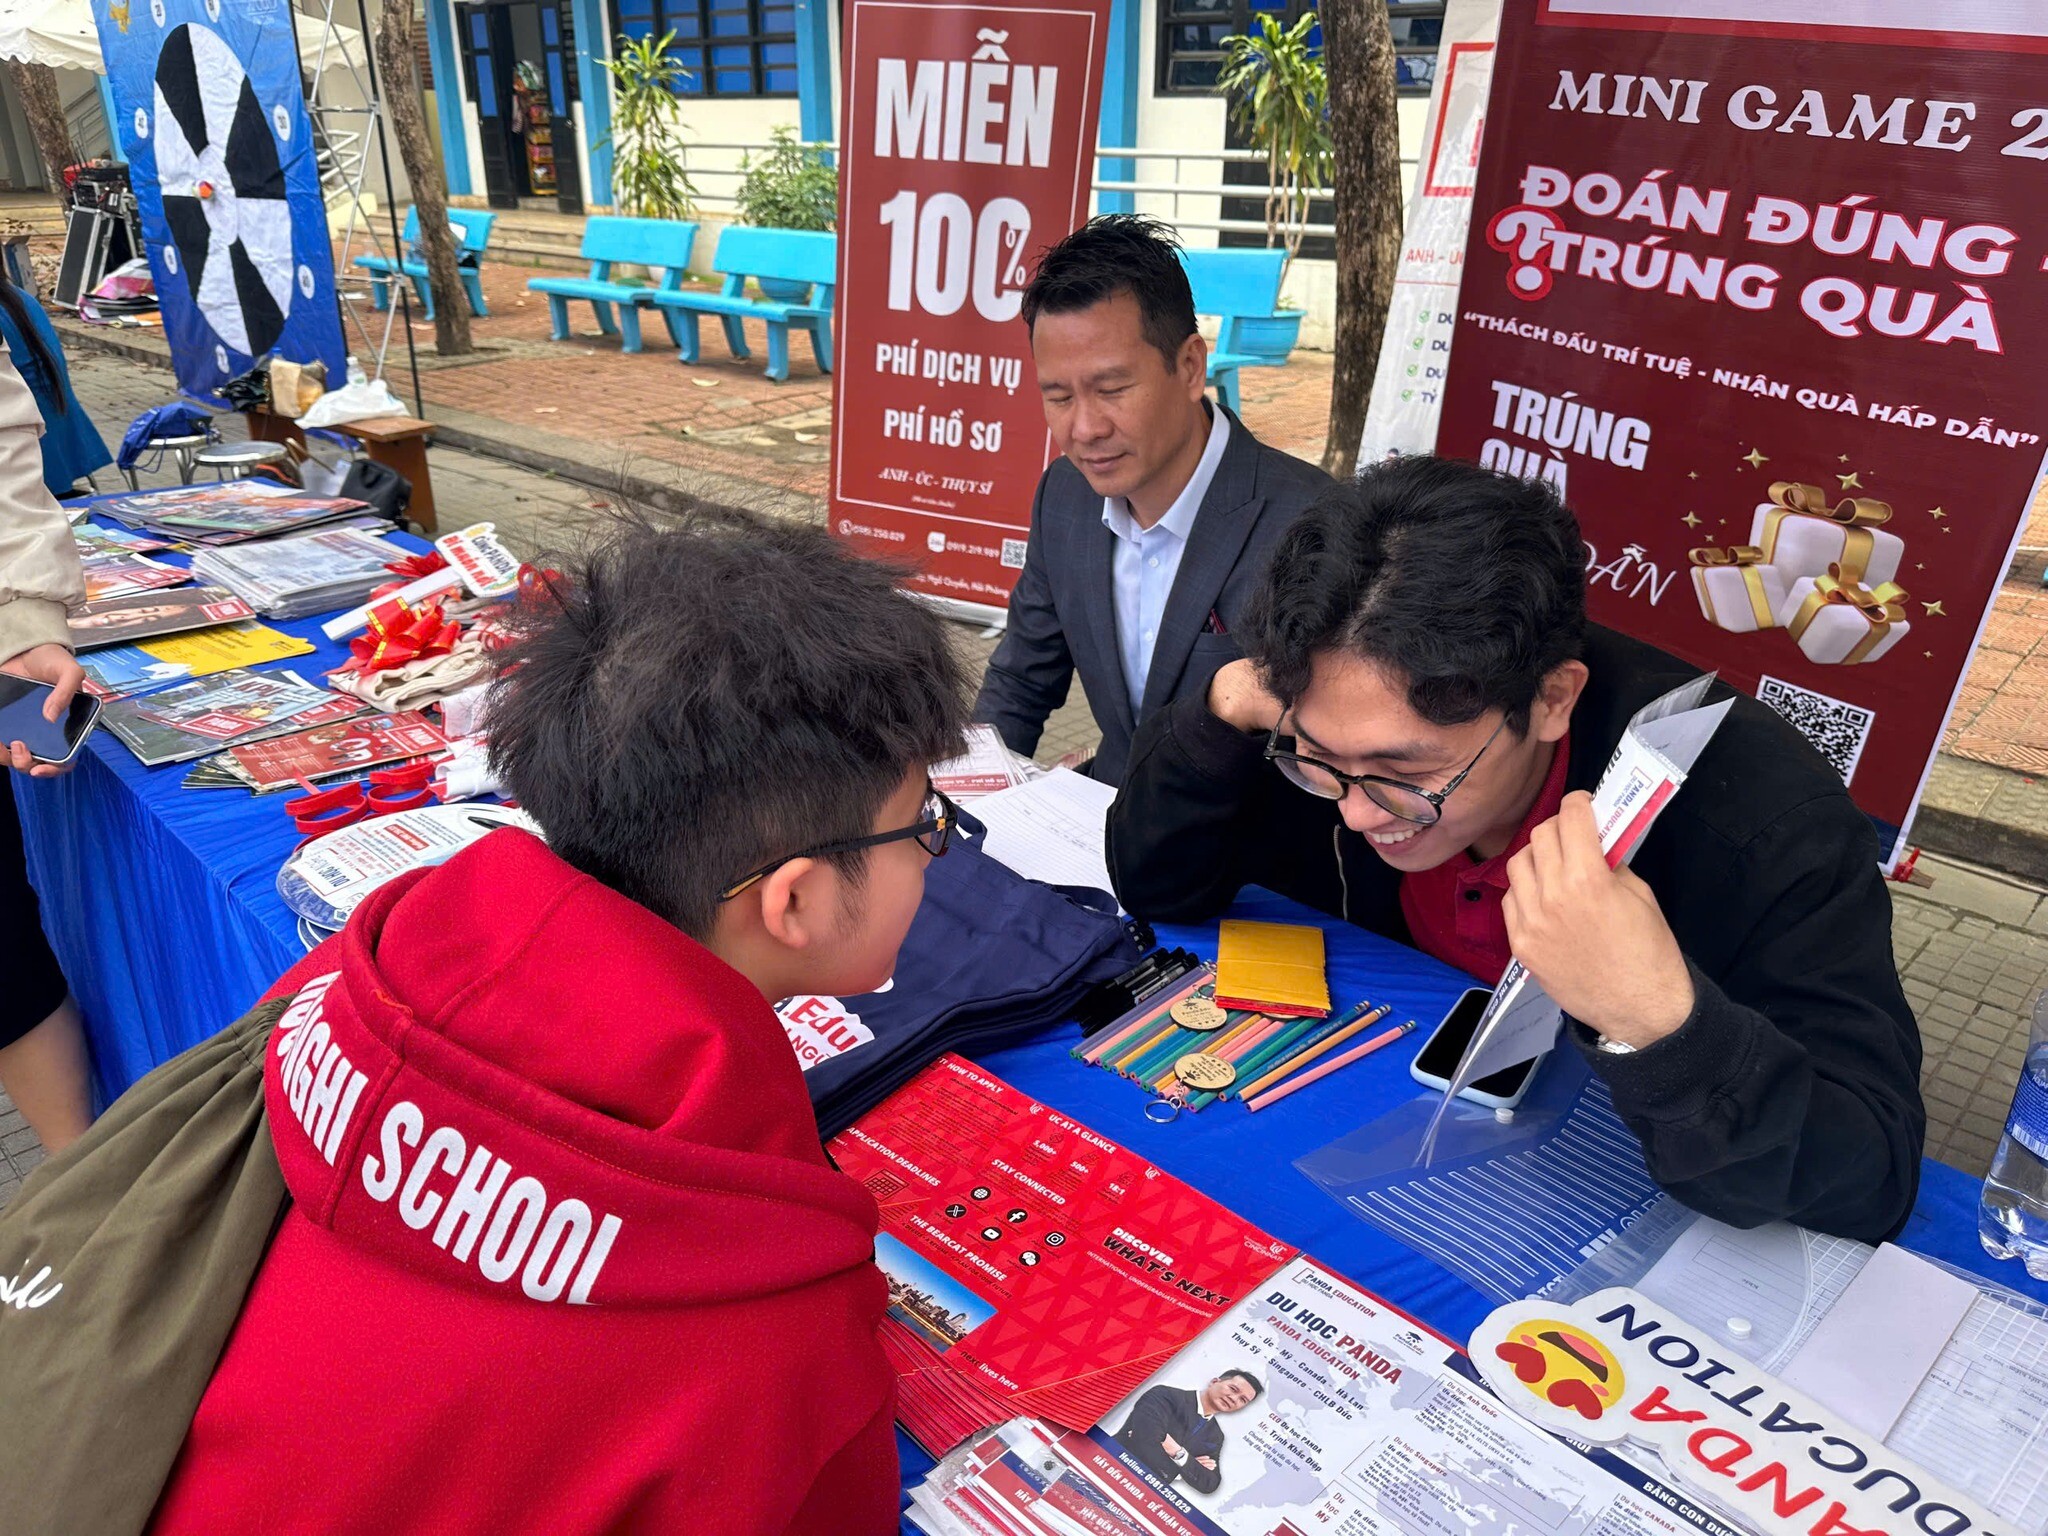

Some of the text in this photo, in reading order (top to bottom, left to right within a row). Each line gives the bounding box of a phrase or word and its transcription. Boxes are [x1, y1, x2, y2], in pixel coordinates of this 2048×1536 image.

[874, 27, 1058, 168] MIỄN
[1548, 70, 1709, 124] MINI
[1727, 85, 1976, 150] GAME
[1519, 165, 2019, 277] ĐOÁN ĐÚNG
[1405, 248, 1434, 264] ANH
[1542, 235, 2004, 355] TRÚNG QUÀ
[875, 339, 1022, 395] PHÍ DỊCH VỤ
[1552, 325, 1595, 357] ĐẤU
[1602, 340, 1640, 365] TRÍ
[1643, 352, 1692, 378] TUỆ
[1712, 368, 1789, 402] NHẬN
[1796, 388, 1858, 418] QUÀ
[1868, 402, 1937, 429] HẤP
[884, 405, 1003, 452] PHÍ HỒ SƠ
[1491, 380, 1651, 471] TRÚNG
[878, 467, 908, 483] ANH
[914, 470, 934, 487] ÚC
[941, 476, 979, 495] THỤY
[1622, 779, 1644, 807] PANDA
[947, 1063, 1004, 1094] HOW TO APPLY
[846, 1127, 897, 1160] APPLICATION
[895, 1156, 941, 1187] DEADLINES
[1049, 1114, 1117, 1154] UC AT A GLANCE
[992, 1159, 1066, 1206] STAY CONNECTED
[910, 1215, 1008, 1282] THE BEARCAT PROMISE
[1087, 1250, 1128, 1278] INTERNATIONAL
[1112, 1227, 1174, 1266] DISCOVER
[1103, 1236, 1231, 1307] WHAT'S NEXT
[1306, 1274, 1377, 1318] PANDA EDUCATION
[1265, 1291, 1299, 1313] DU
[1294, 1308, 1338, 1340] HỌC
[1335, 1334, 1402, 1384] PANDA
[1267, 1315, 1301, 1341] PANDA
[1301, 1338, 1361, 1380] EDUCATION
[979, 1362, 998, 1380] lives
[998, 1375, 1019, 1391] here
[1239, 1322, 1255, 1335] Anh
[1280, 1349, 1292, 1360] Mỹ
[1298, 1362, 1328, 1385] Canada
[1336, 1387, 1348, 1399] Hà
[1348, 1395, 1364, 1410] Lan
[1268, 1358, 1307, 1388] Singapore
[1313, 1389, 1335, 1408] CHLB
[1466, 1395, 1480, 1407] Anh
[1596, 1302, 2000, 1536] DUCATION
[1268, 1412, 1282, 1424] CEO
[1301, 1436, 1323, 1454] PANDA
[1269, 1430, 1288, 1447] Trịnh
[1119, 1452, 1192, 1514] Hotline: 0981.250.029
[1629, 1386, 1890, 1536] ANDA
[1093, 1455, 1109, 1469] HÃY
[1120, 1477, 1145, 1500] PANDA
[1177, 1526, 1196, 1536] VIS
[1315, 1510, 1330, 1524] Mỹ
[1324, 1501, 1340, 1516] học
[1333, 1492, 1345, 1504] Du
[1678, 1504, 1706, 1525] CON
[1644, 1510, 1676, 1533] CANADA
